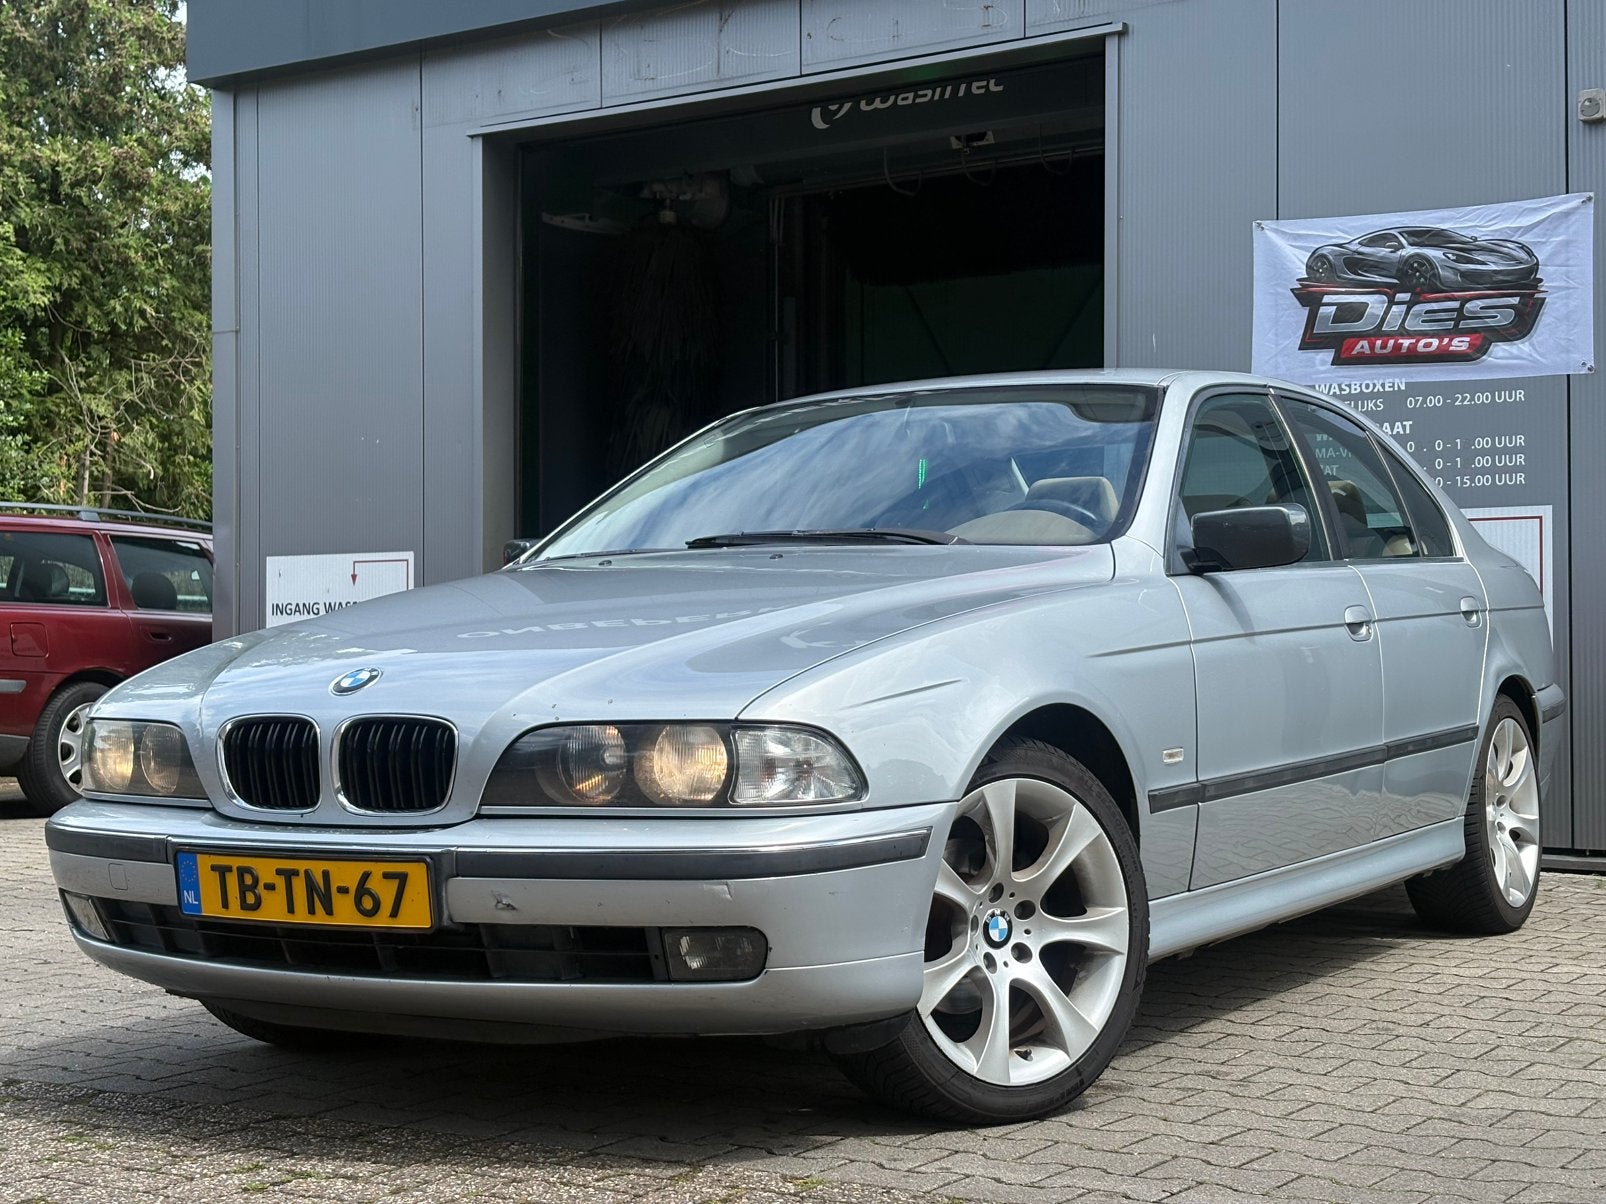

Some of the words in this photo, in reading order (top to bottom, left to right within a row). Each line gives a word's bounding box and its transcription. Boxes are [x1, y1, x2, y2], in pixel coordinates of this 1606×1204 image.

[1351, 336, 1471, 355] AUTO'S
[1315, 378, 1406, 395] WASBOXEN
[1406, 395, 1443, 409] 07.00
[1454, 392, 1491, 406] 22.00
[1495, 389, 1525, 403] UUR
[1377, 421, 1413, 436] AAT
[1495, 434, 1525, 447] UUR
[1320, 464, 1340, 476] AT
[1495, 453, 1525, 467] UUR
[1455, 474, 1491, 488] 15.00
[1495, 472, 1525, 485] UUR
[271, 601, 320, 616] INGANG
[183, 889, 199, 905] NL
[210, 863, 409, 918] TB-TN-67
